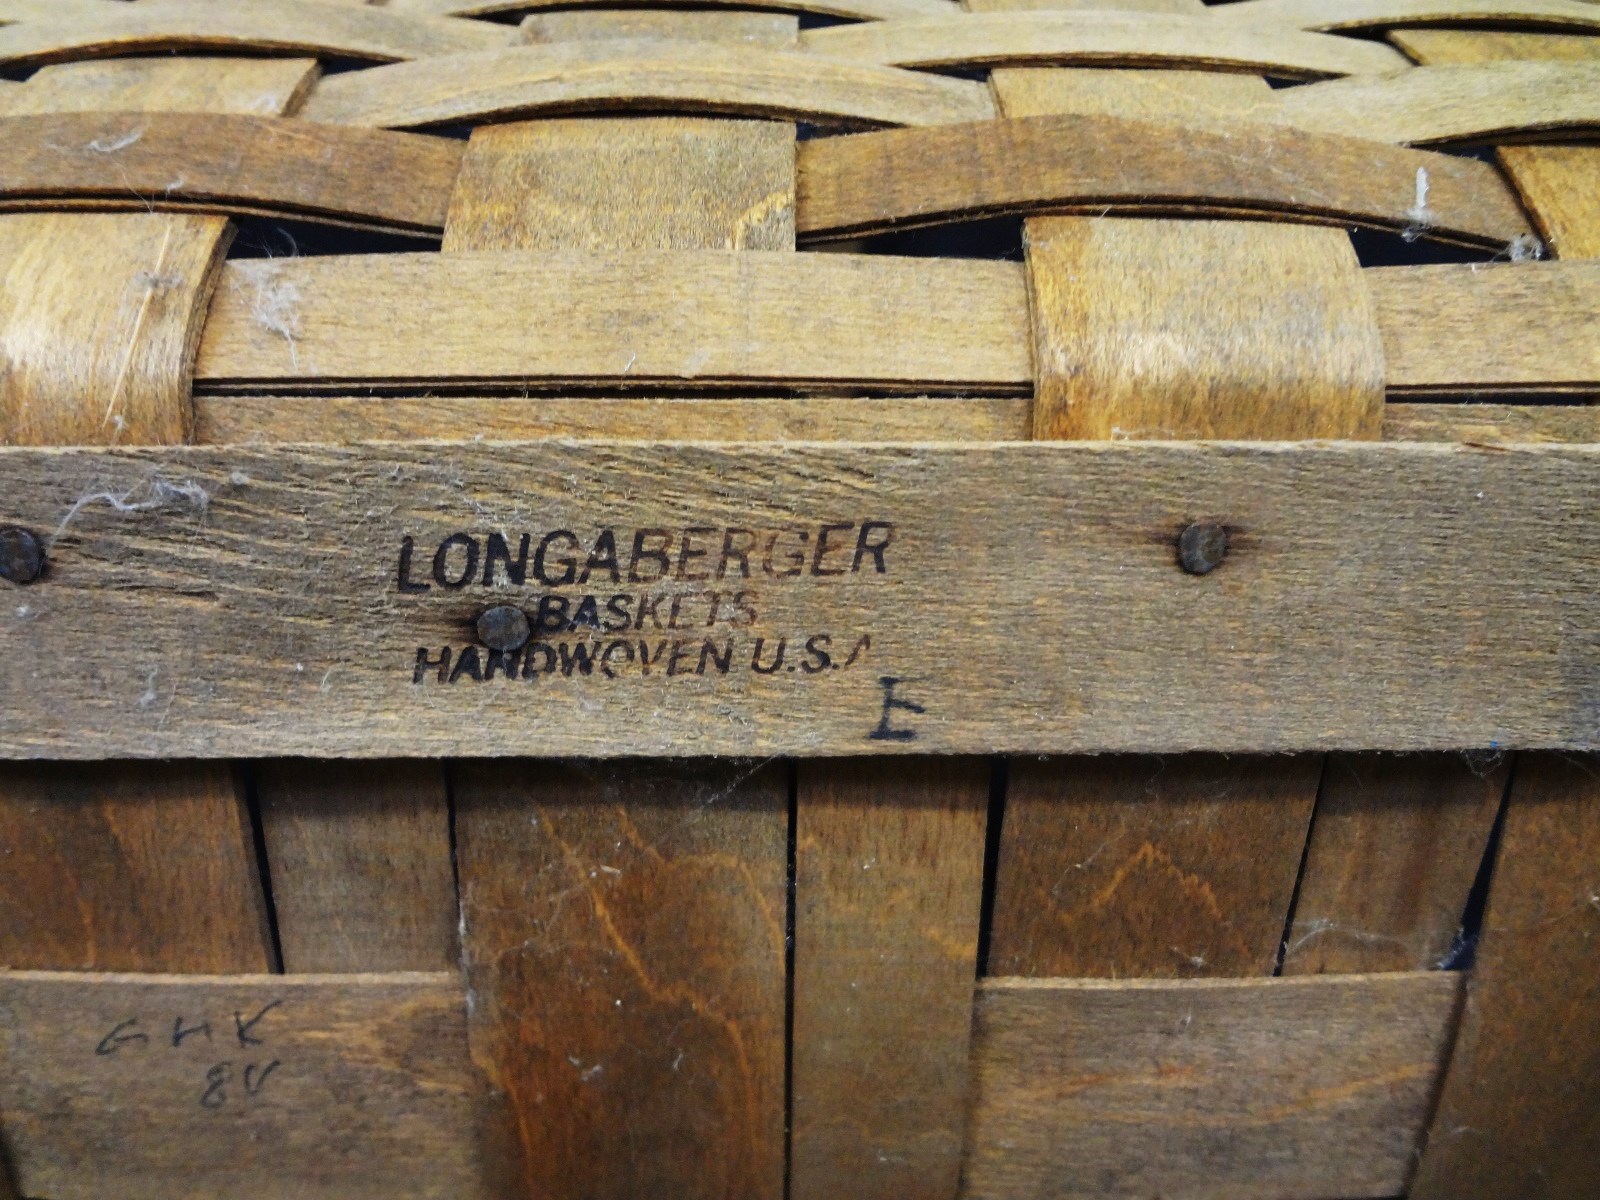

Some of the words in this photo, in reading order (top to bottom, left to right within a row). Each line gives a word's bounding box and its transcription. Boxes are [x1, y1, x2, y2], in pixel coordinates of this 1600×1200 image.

[398, 520, 895, 593] LONGABERGER
[535, 593, 760, 633] BASKETS
[413, 635, 734, 684] HANDWOVEN
